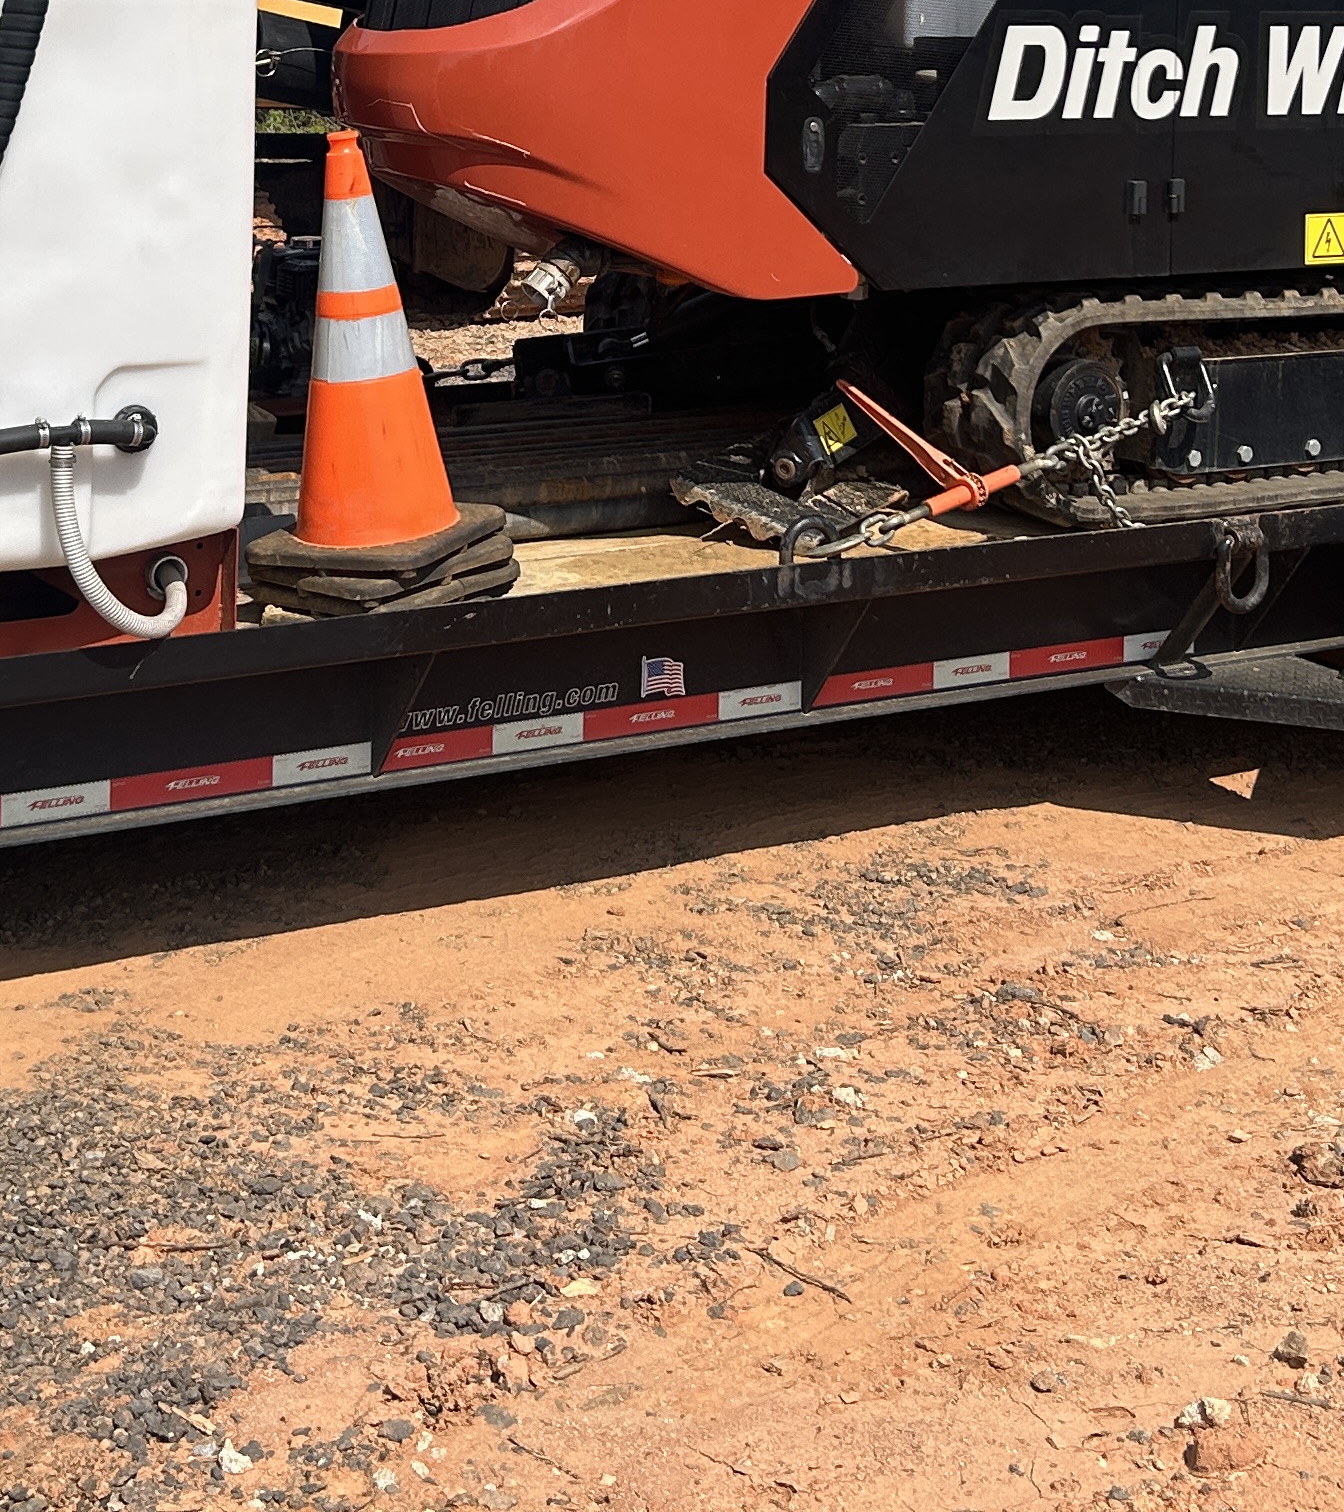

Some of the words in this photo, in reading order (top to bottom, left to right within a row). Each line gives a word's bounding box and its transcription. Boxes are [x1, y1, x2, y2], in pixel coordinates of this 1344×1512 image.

[987, 25, 1240, 121] Ditch
[394, 742, 445, 758] FELLING
[296, 756, 349, 772] FELLING
[165, 775, 221, 791] FELLING
[27, 794, 85, 811] FELLING
